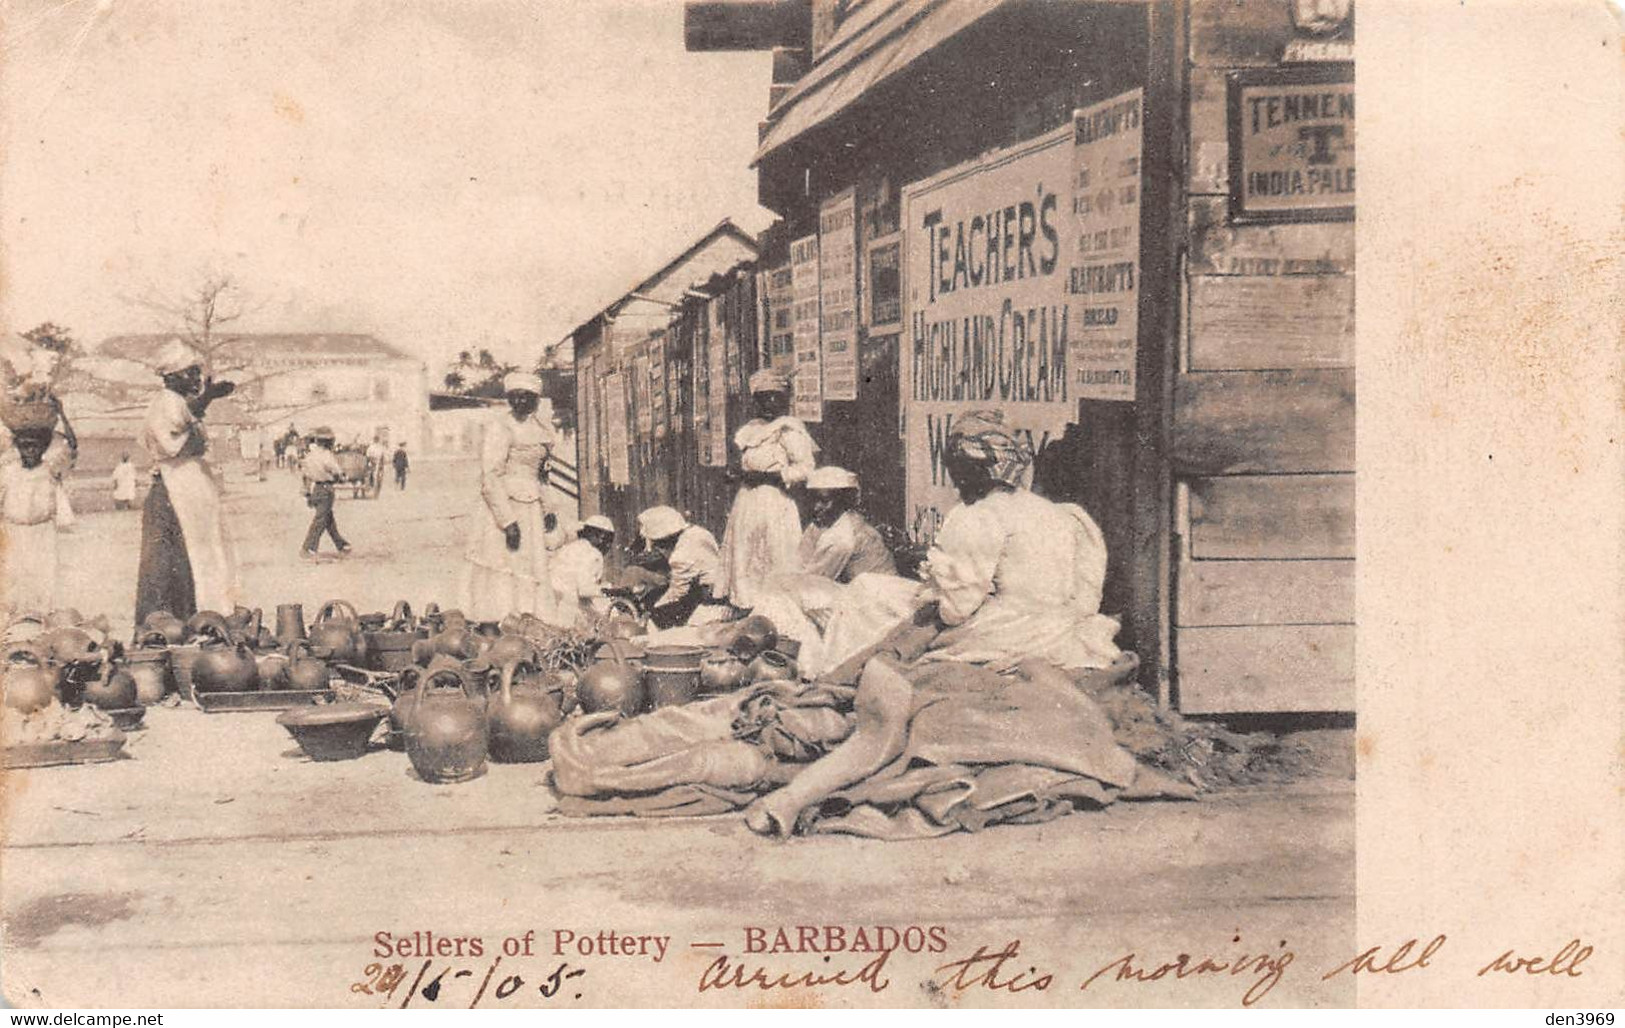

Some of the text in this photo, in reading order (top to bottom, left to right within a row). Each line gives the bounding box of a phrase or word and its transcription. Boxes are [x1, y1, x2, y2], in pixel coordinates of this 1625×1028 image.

[999, 297, 1069, 402] CREAM
[1080, 927, 1296, 1006] morning
[1322, 934, 1447, 981] all
[1477, 938, 1594, 977] well
